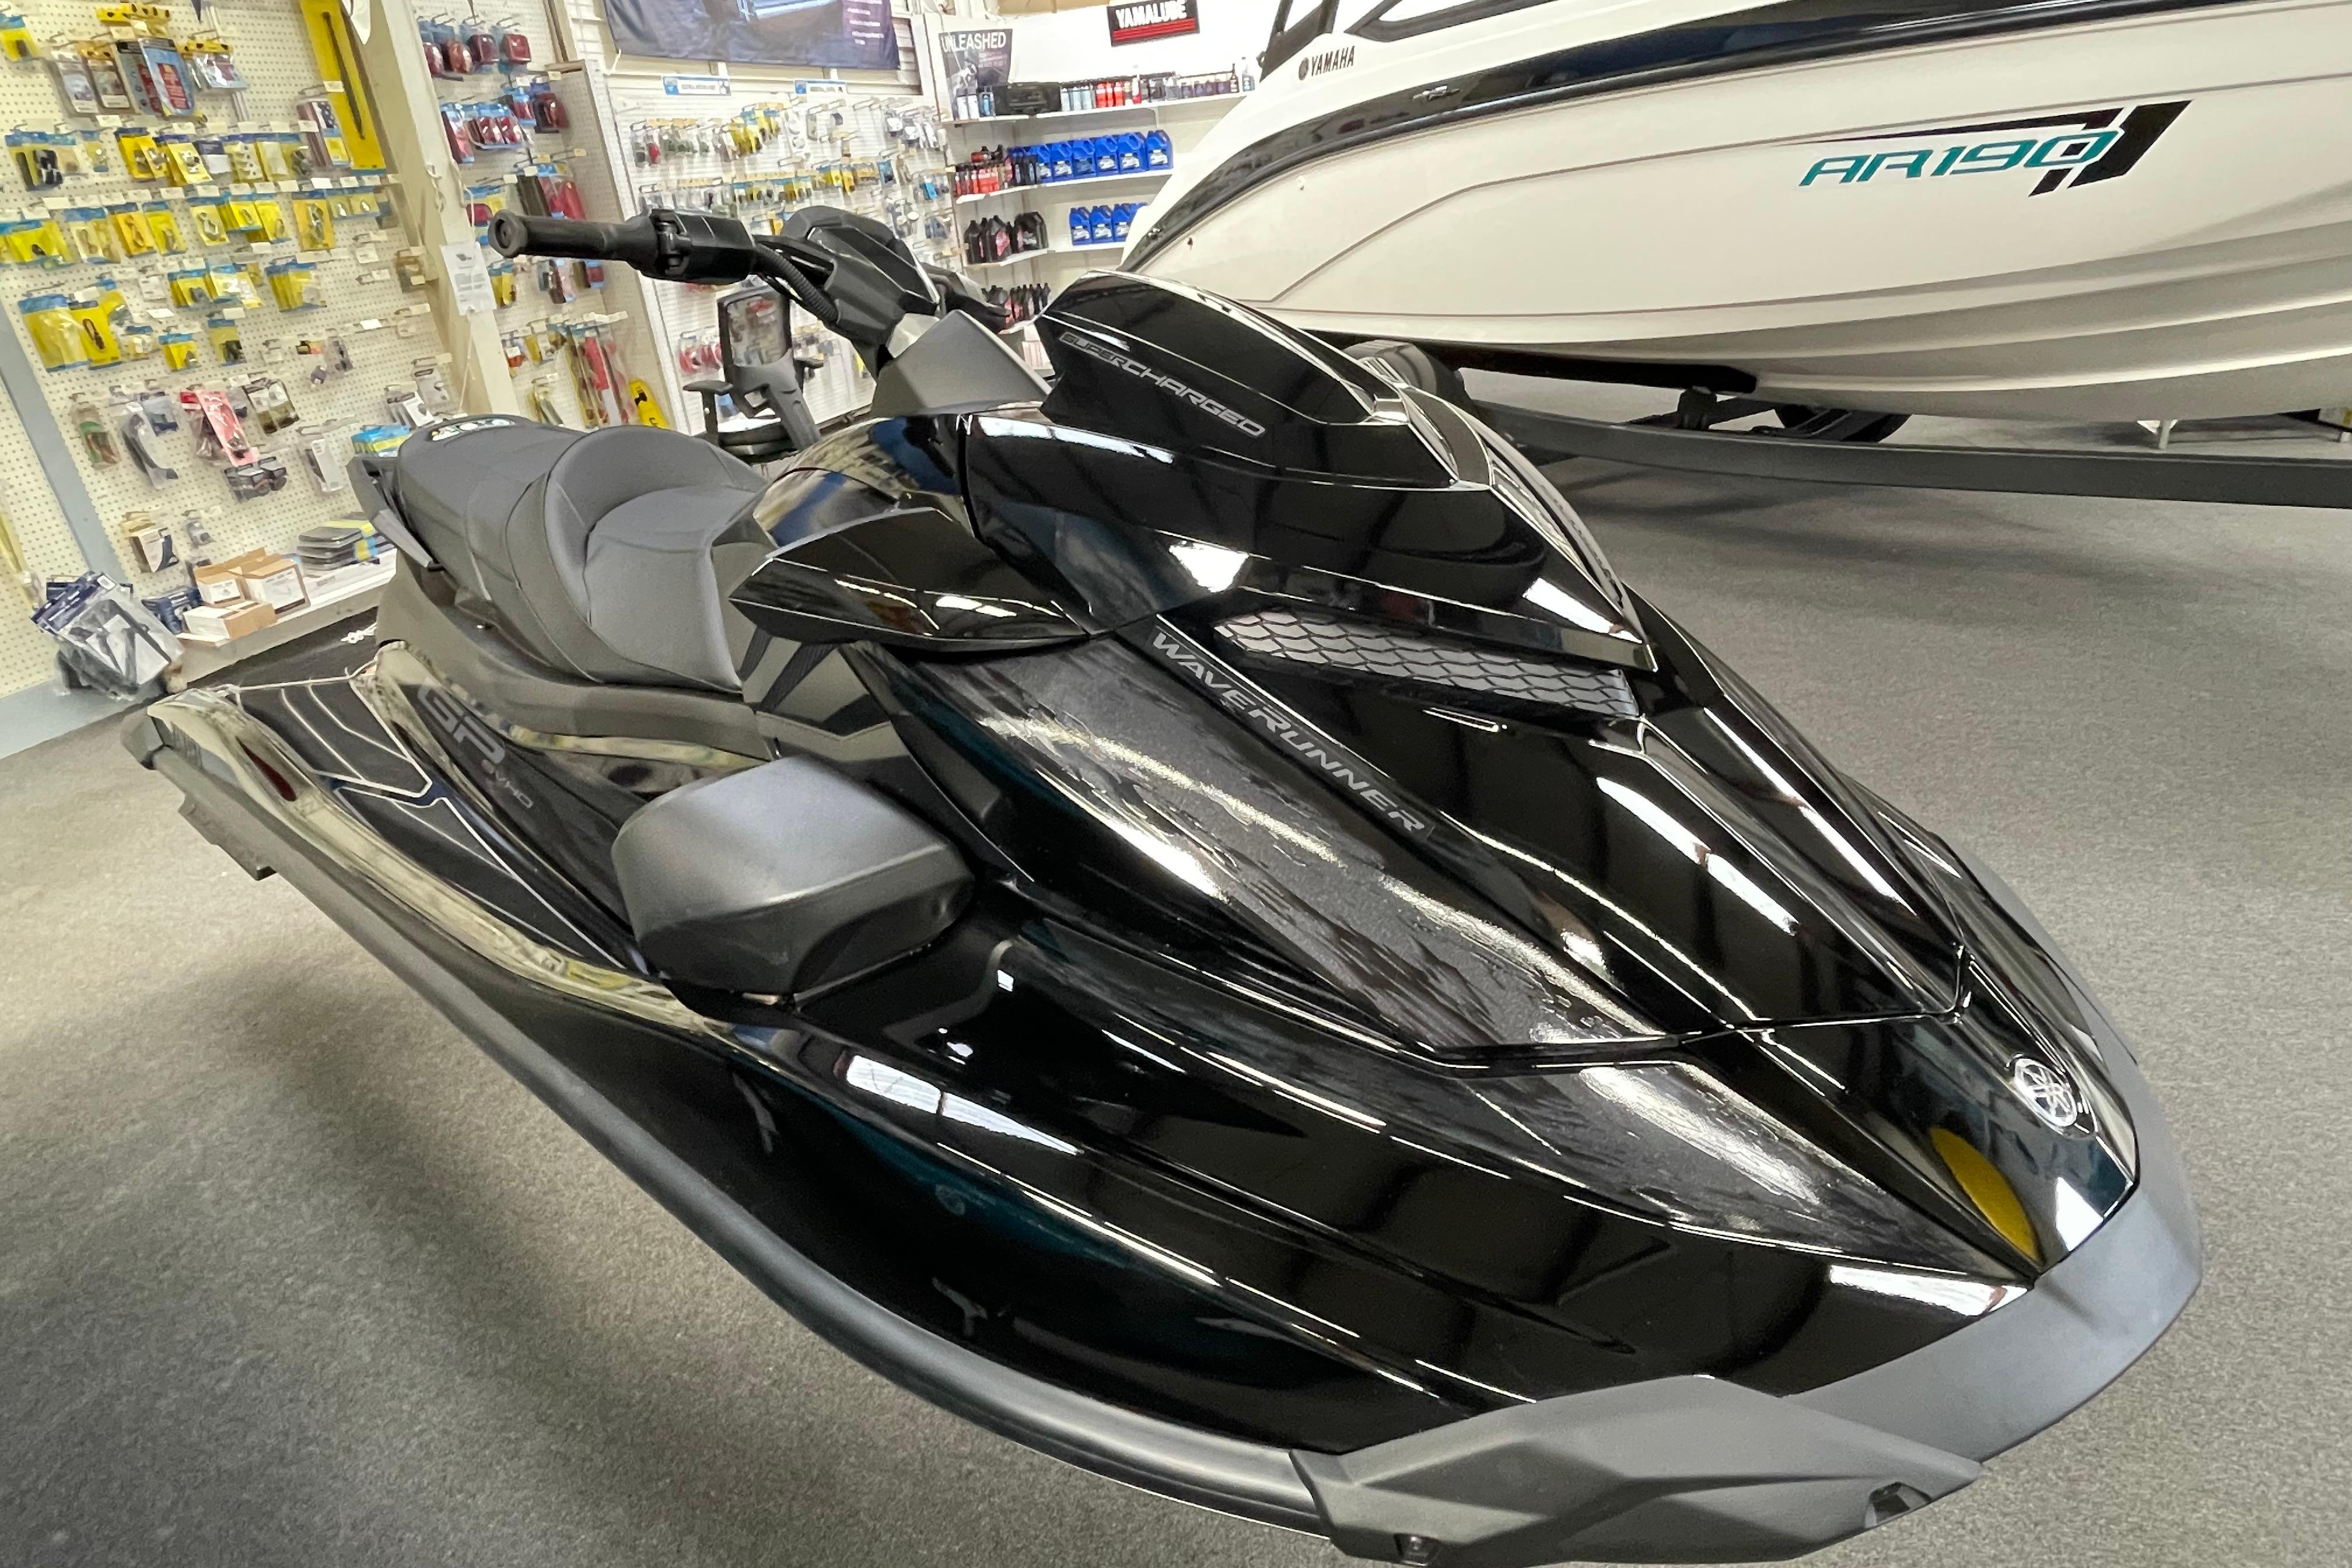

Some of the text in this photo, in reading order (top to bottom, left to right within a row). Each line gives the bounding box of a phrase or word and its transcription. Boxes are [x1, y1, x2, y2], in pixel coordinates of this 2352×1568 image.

[941, 32, 1006, 52] UNLEASHED
[1115, 0, 1187, 29] YAMALUBE
[1311, 46, 1355, 76] YAMAHA
[1798, 130, 2120, 187] AR190
[1059, 331, 1266, 436] SUPERCHARGED
[418, 684, 505, 764] GP
[1153, 632, 1425, 831] WAVERUNNER
